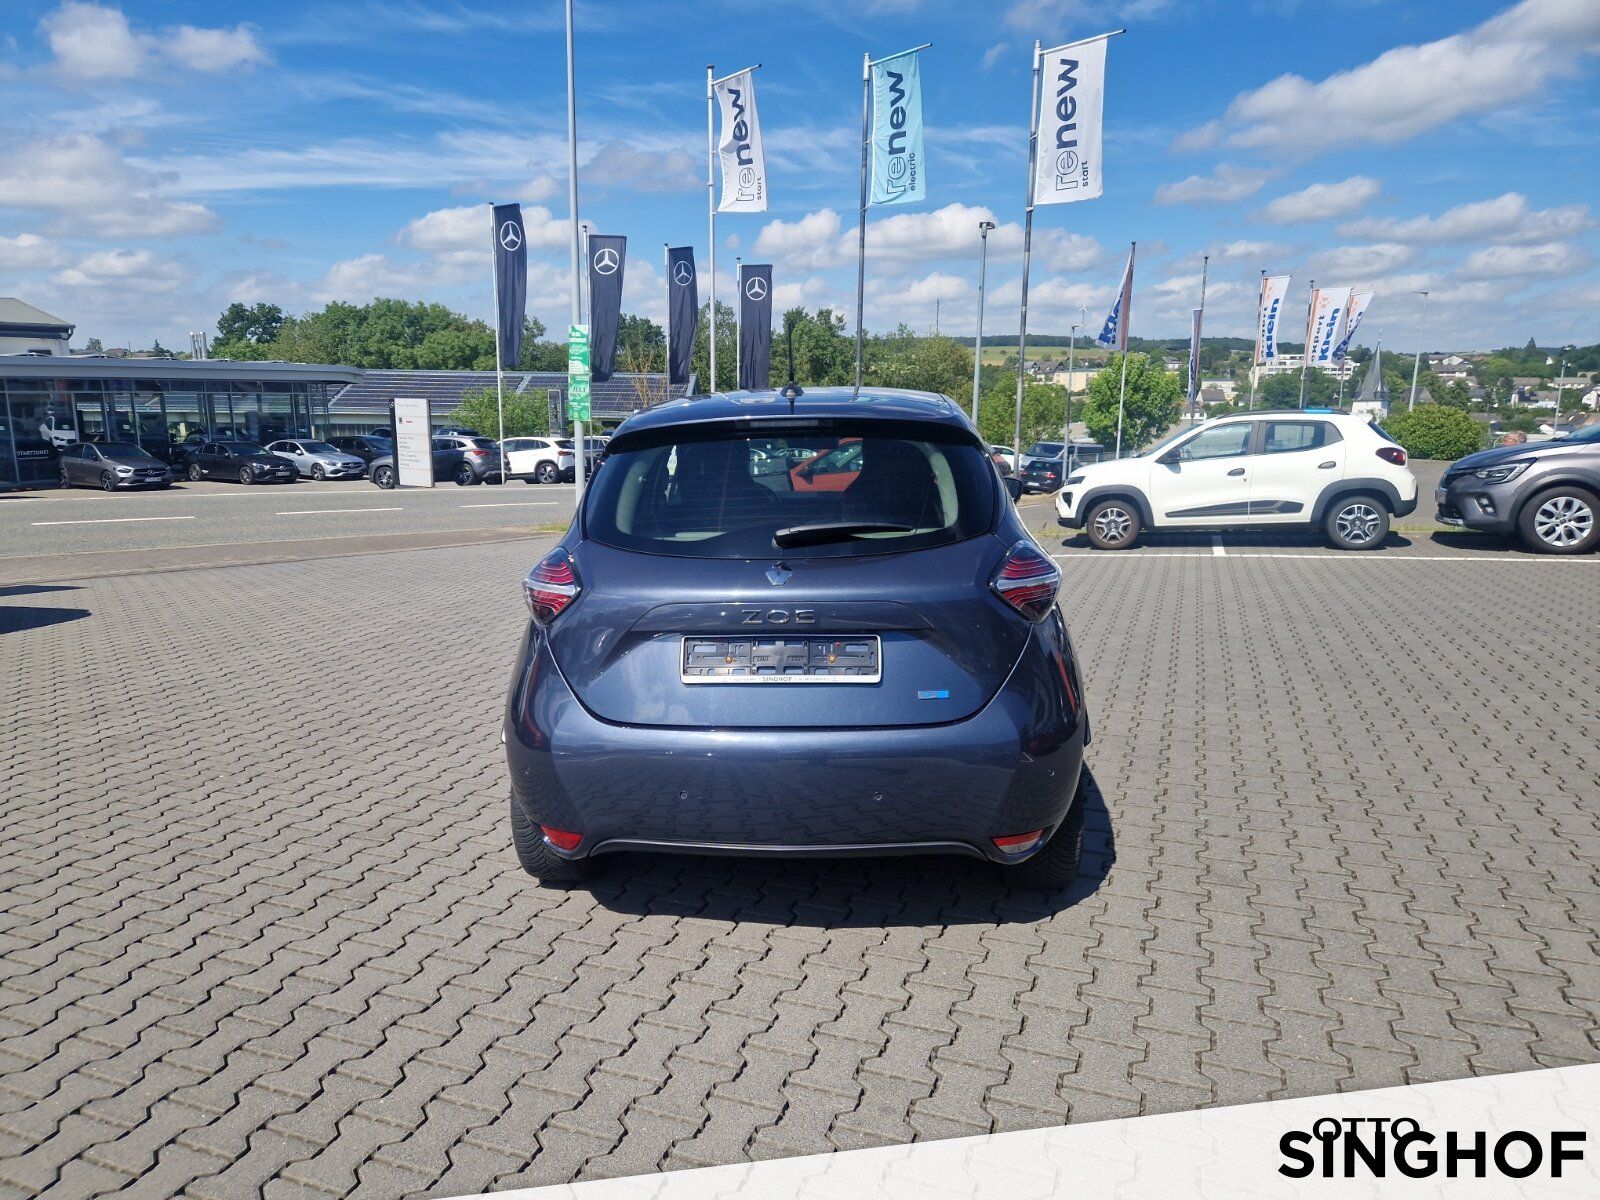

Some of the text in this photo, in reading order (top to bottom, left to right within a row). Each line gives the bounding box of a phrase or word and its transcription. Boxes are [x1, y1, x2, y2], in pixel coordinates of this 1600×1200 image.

[727, 88, 756, 202] renew
[886, 71, 907, 194] renew
[1055, 58, 1079, 192] renew
[909, 152, 917, 192] electric
[1081, 160, 1089, 187] start
[741, 609, 816, 624] ZOE
